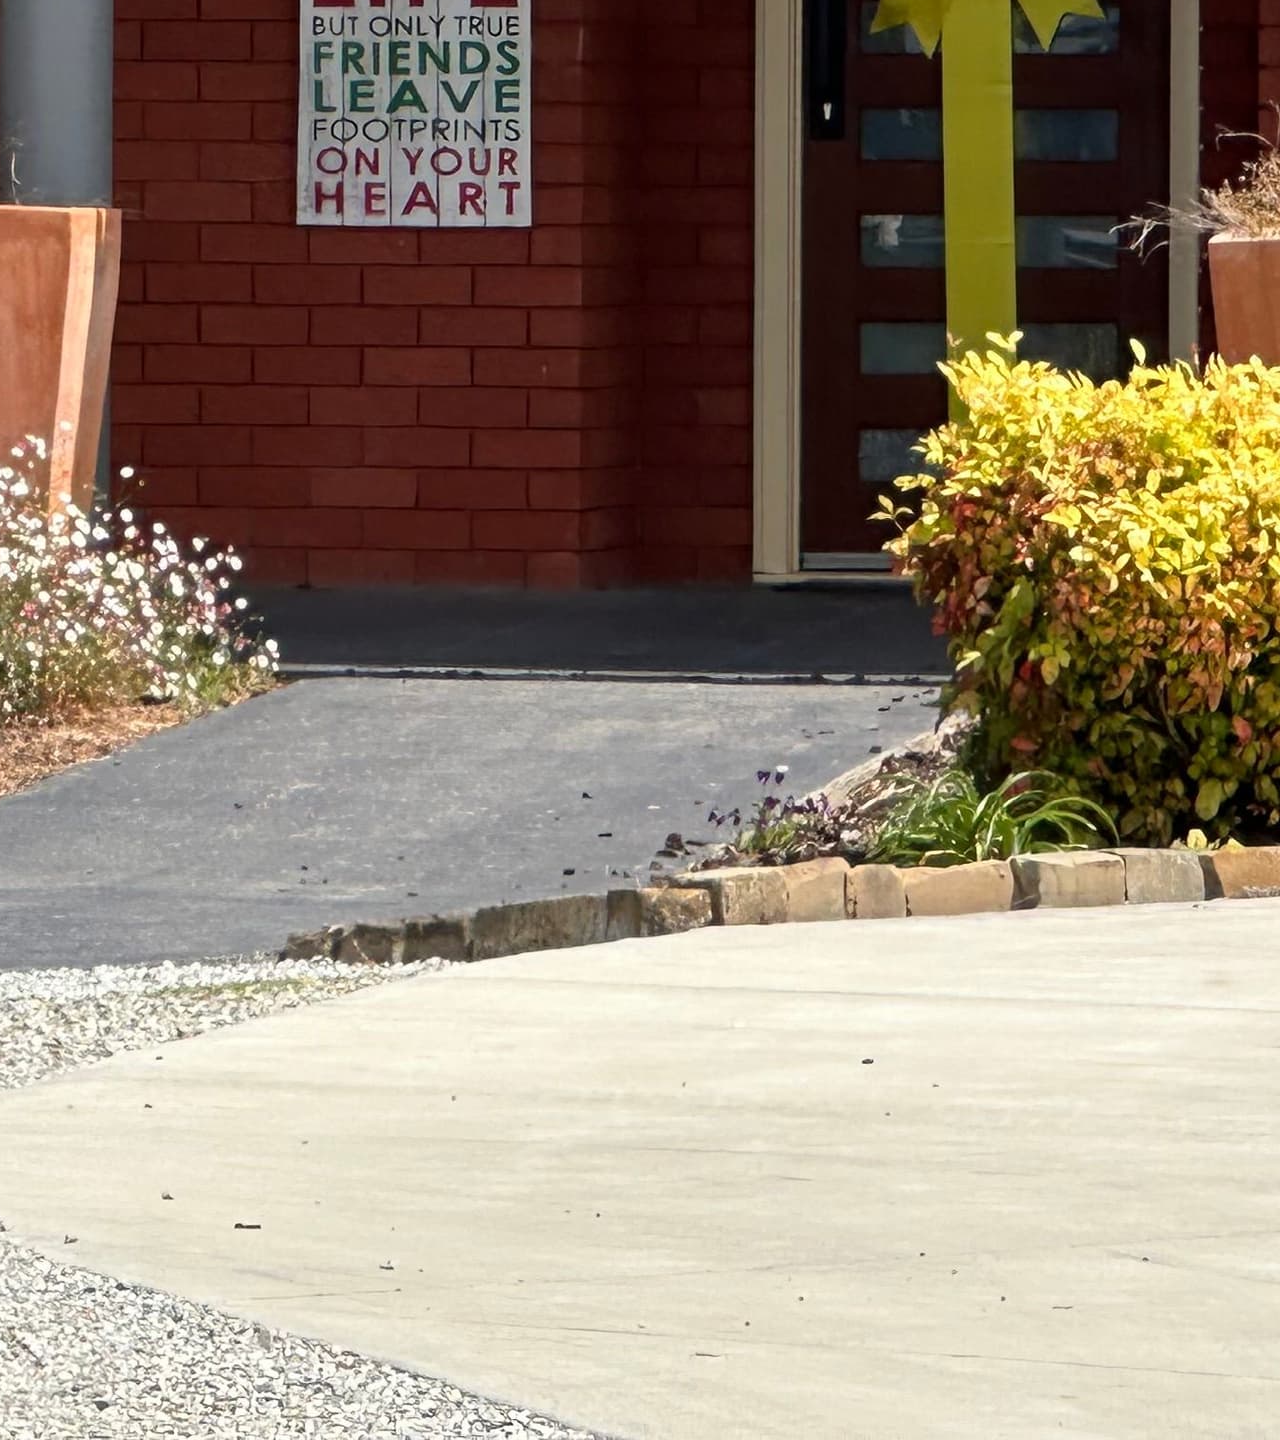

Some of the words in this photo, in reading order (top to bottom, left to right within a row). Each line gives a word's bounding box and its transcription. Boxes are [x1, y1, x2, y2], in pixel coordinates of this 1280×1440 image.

[312, 16, 359, 36] BUT
[369, 15, 446, 37] ONLY
[453, 16, 520, 36] TRUE
[313, 40, 521, 76] FRIENDS
[314, 79, 521, 113] LEAVE
[313, 117, 521, 144] FOOTPRINTS
[316, 146, 379, 176] ON
[401, 146, 518, 176] YOUR
[314, 181, 521, 216] HEART
